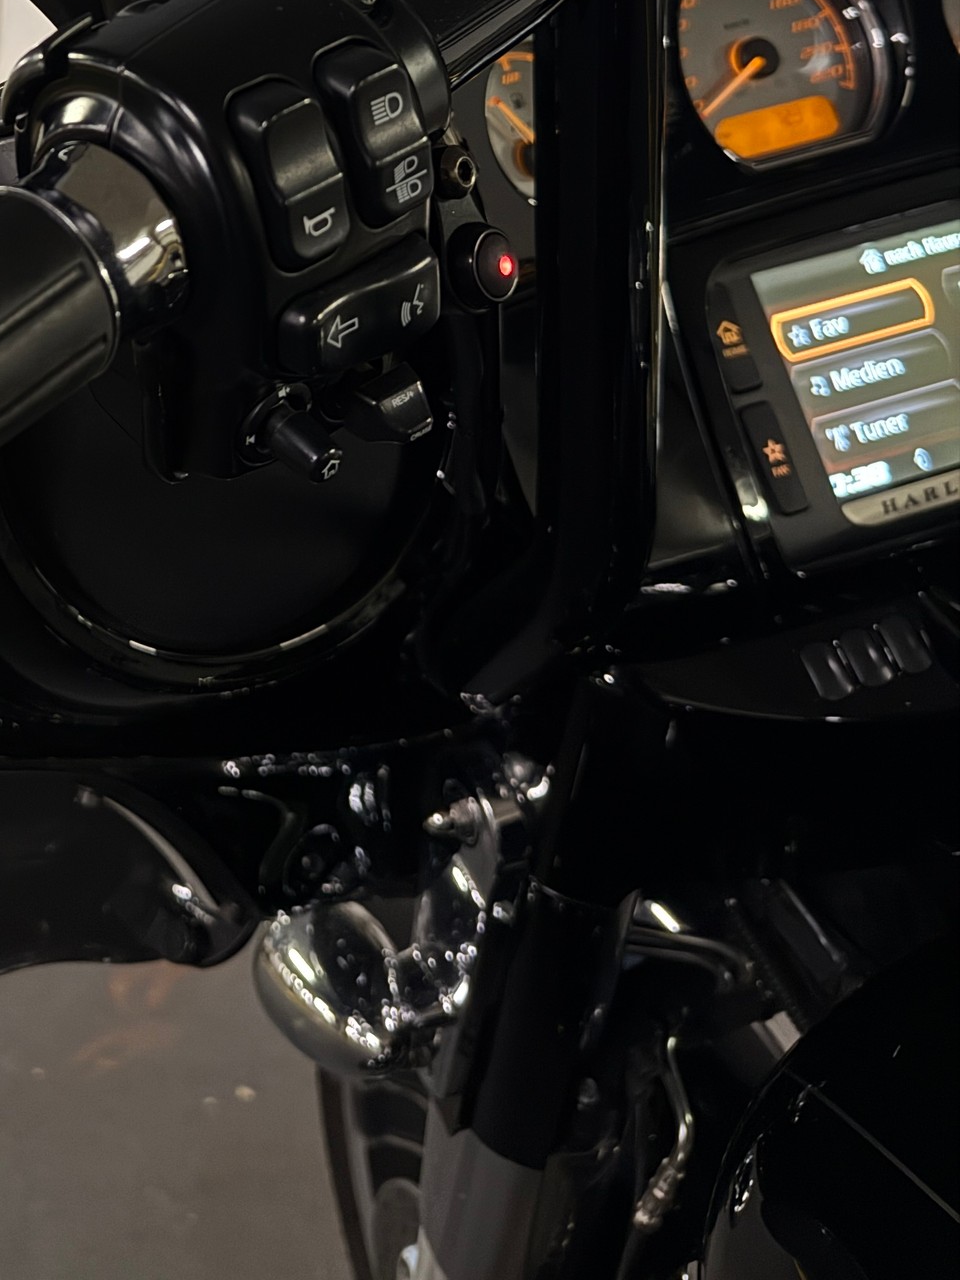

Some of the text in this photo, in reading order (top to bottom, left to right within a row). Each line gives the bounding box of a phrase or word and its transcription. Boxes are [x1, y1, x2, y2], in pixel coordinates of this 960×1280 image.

[809, 316, 849, 340] Fav
[829, 358, 906, 392] Medien
[849, 413, 909, 443] Tuner
